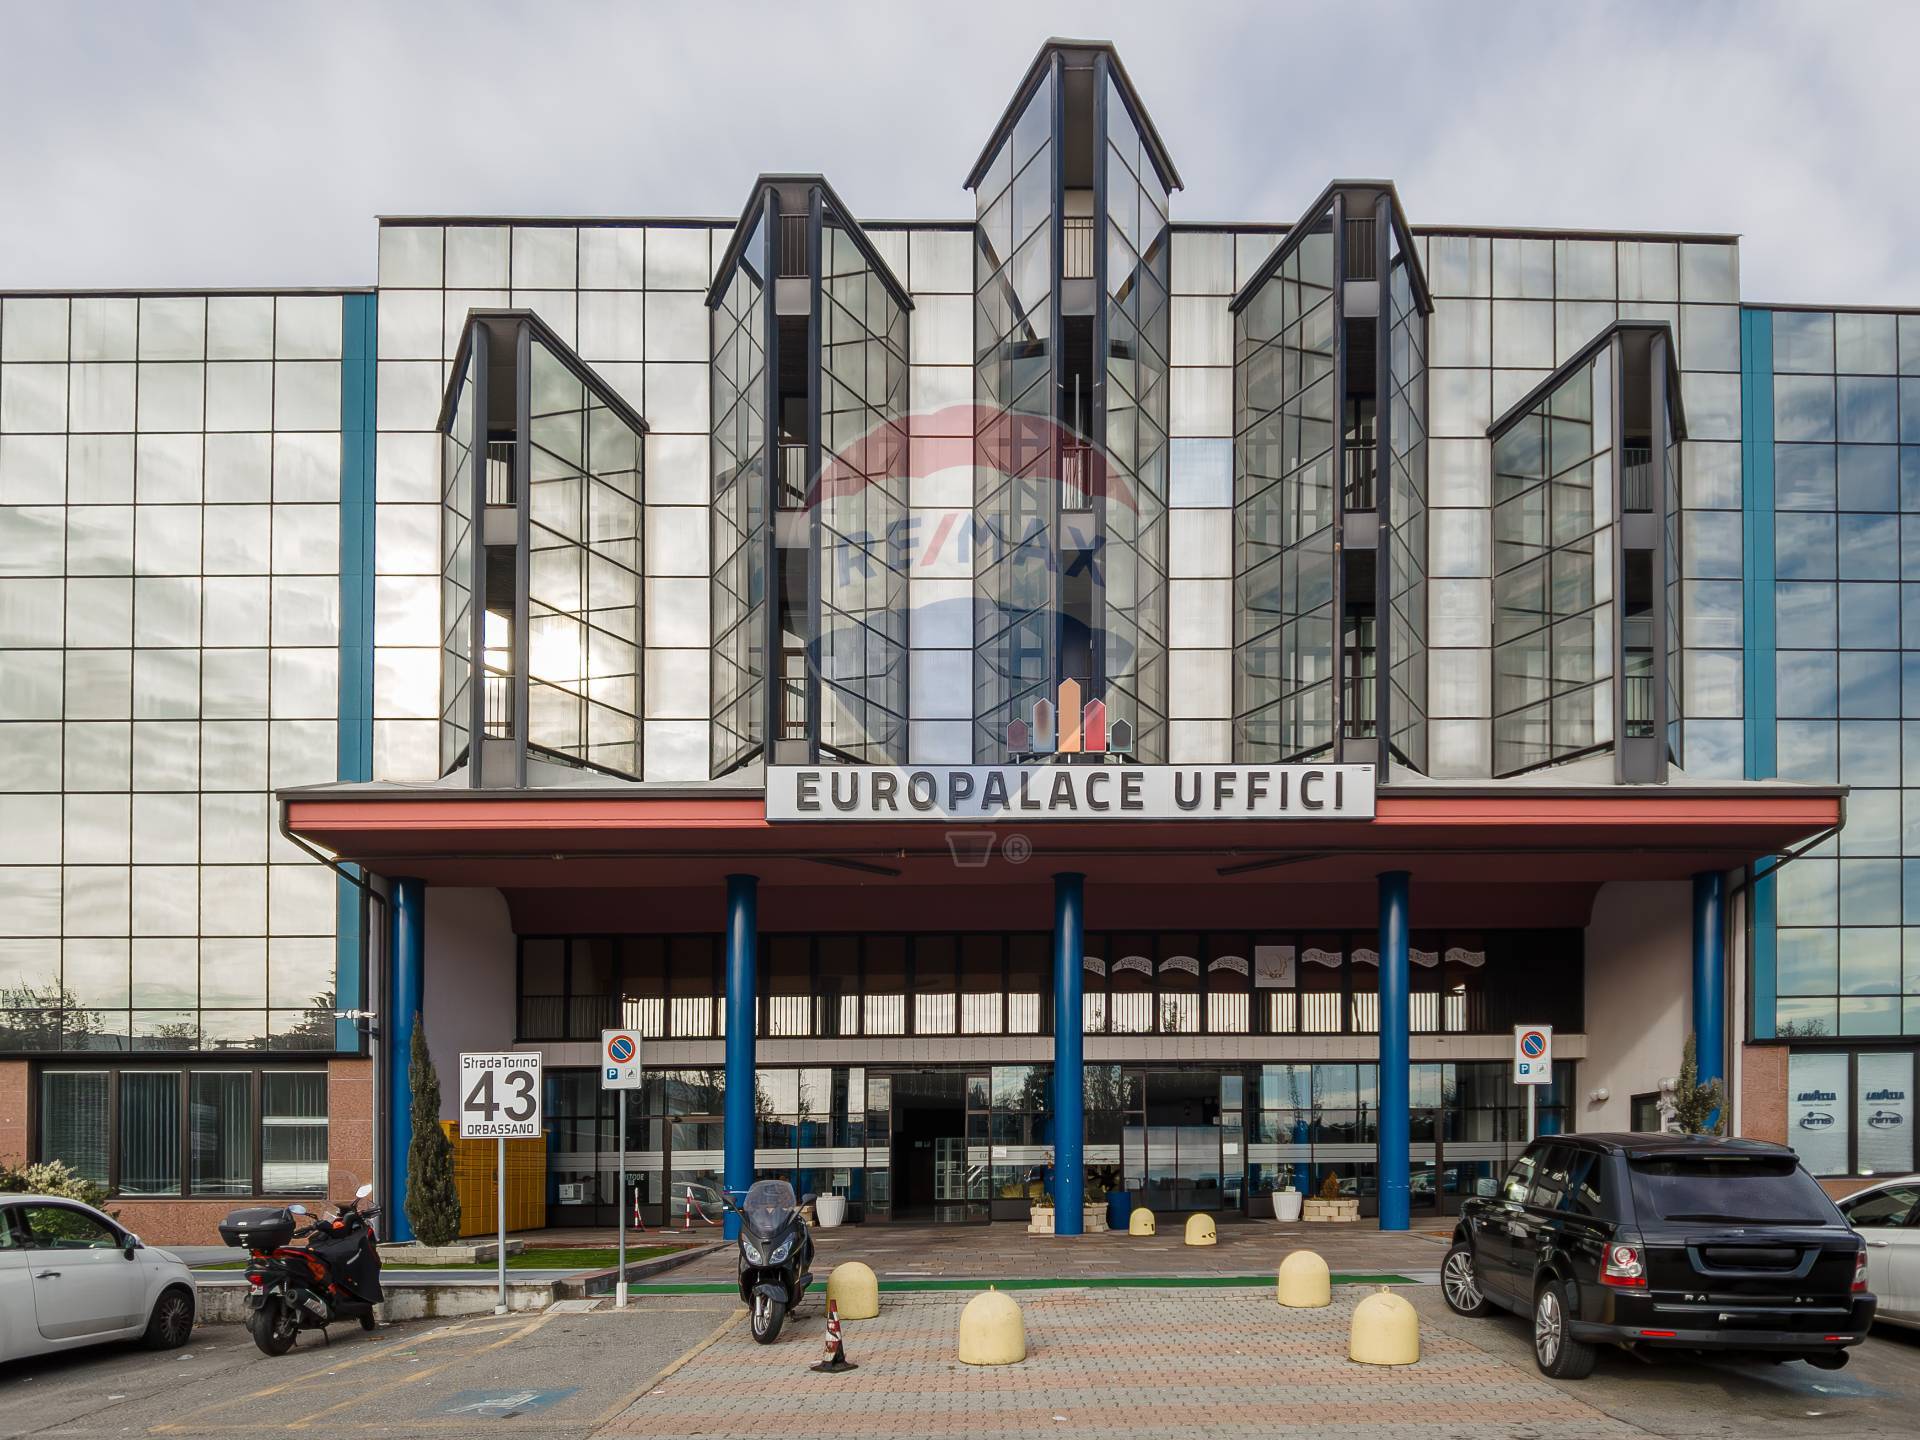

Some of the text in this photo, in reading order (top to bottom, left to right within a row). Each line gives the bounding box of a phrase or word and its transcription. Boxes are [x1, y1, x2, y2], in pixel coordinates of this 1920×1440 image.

[795, 770, 1344, 811] EUROPALACE UFFICI
[464, 1070, 537, 1122] 43
[467, 1123, 534, 1135] ORBASSANO
